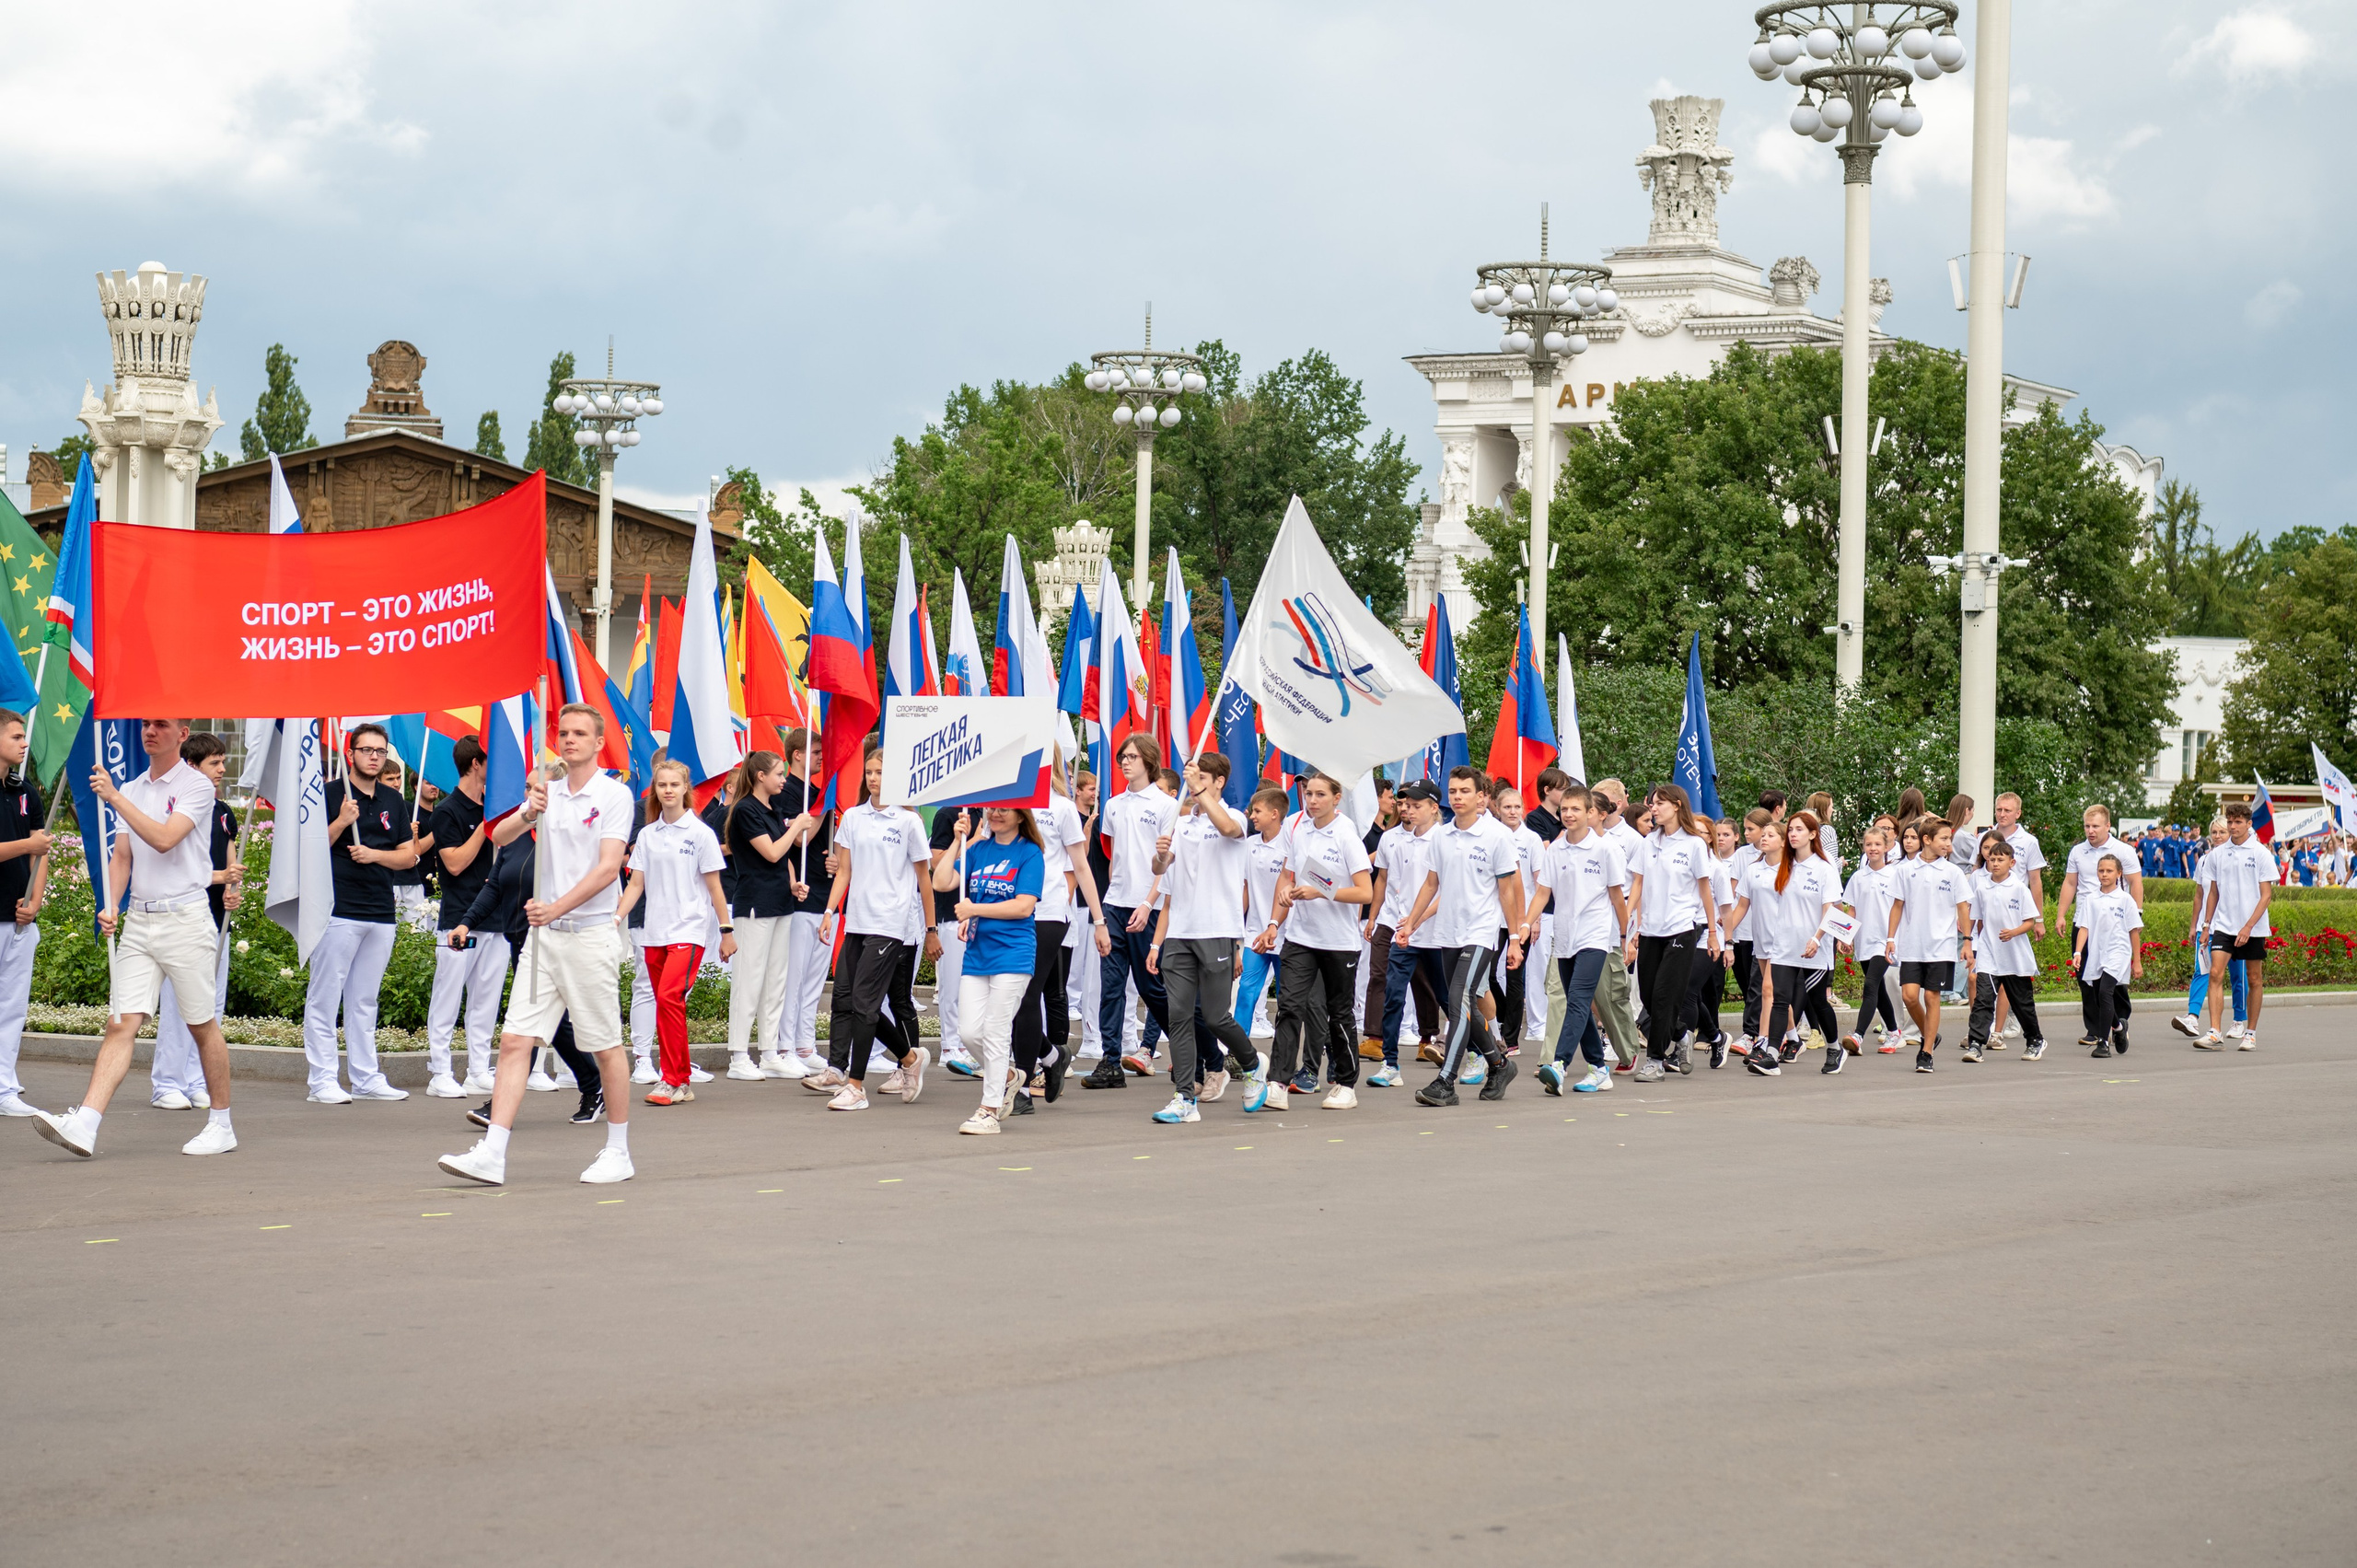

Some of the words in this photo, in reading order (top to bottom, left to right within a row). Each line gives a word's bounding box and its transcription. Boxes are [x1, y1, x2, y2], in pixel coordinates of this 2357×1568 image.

[241, 601, 335, 626] СПОРТ
[362, 594, 412, 621] ЭТО
[416, 577, 494, 615] ЖИЗНЬ,
[240, 636, 341, 660] ЖИЗНЬ
[367, 628, 416, 656] ЭТО
[421, 610, 495, 648] СПОРТ!
[1292, 691, 1332, 724] ФЕДЕРАЦИЯ
[909, 714, 969, 771] ЛЕГКАЯ
[907, 733, 983, 799] АТЛЕТИКА
[882, 835, 901, 845] ВФЛА
[1323, 854, 1340, 864] ВФЛА
[1469, 854, 1487, 863] ВФЛА
[1672, 858, 1689, 866] ВФЛА
[1803, 885, 1819, 893] ВФЛА
